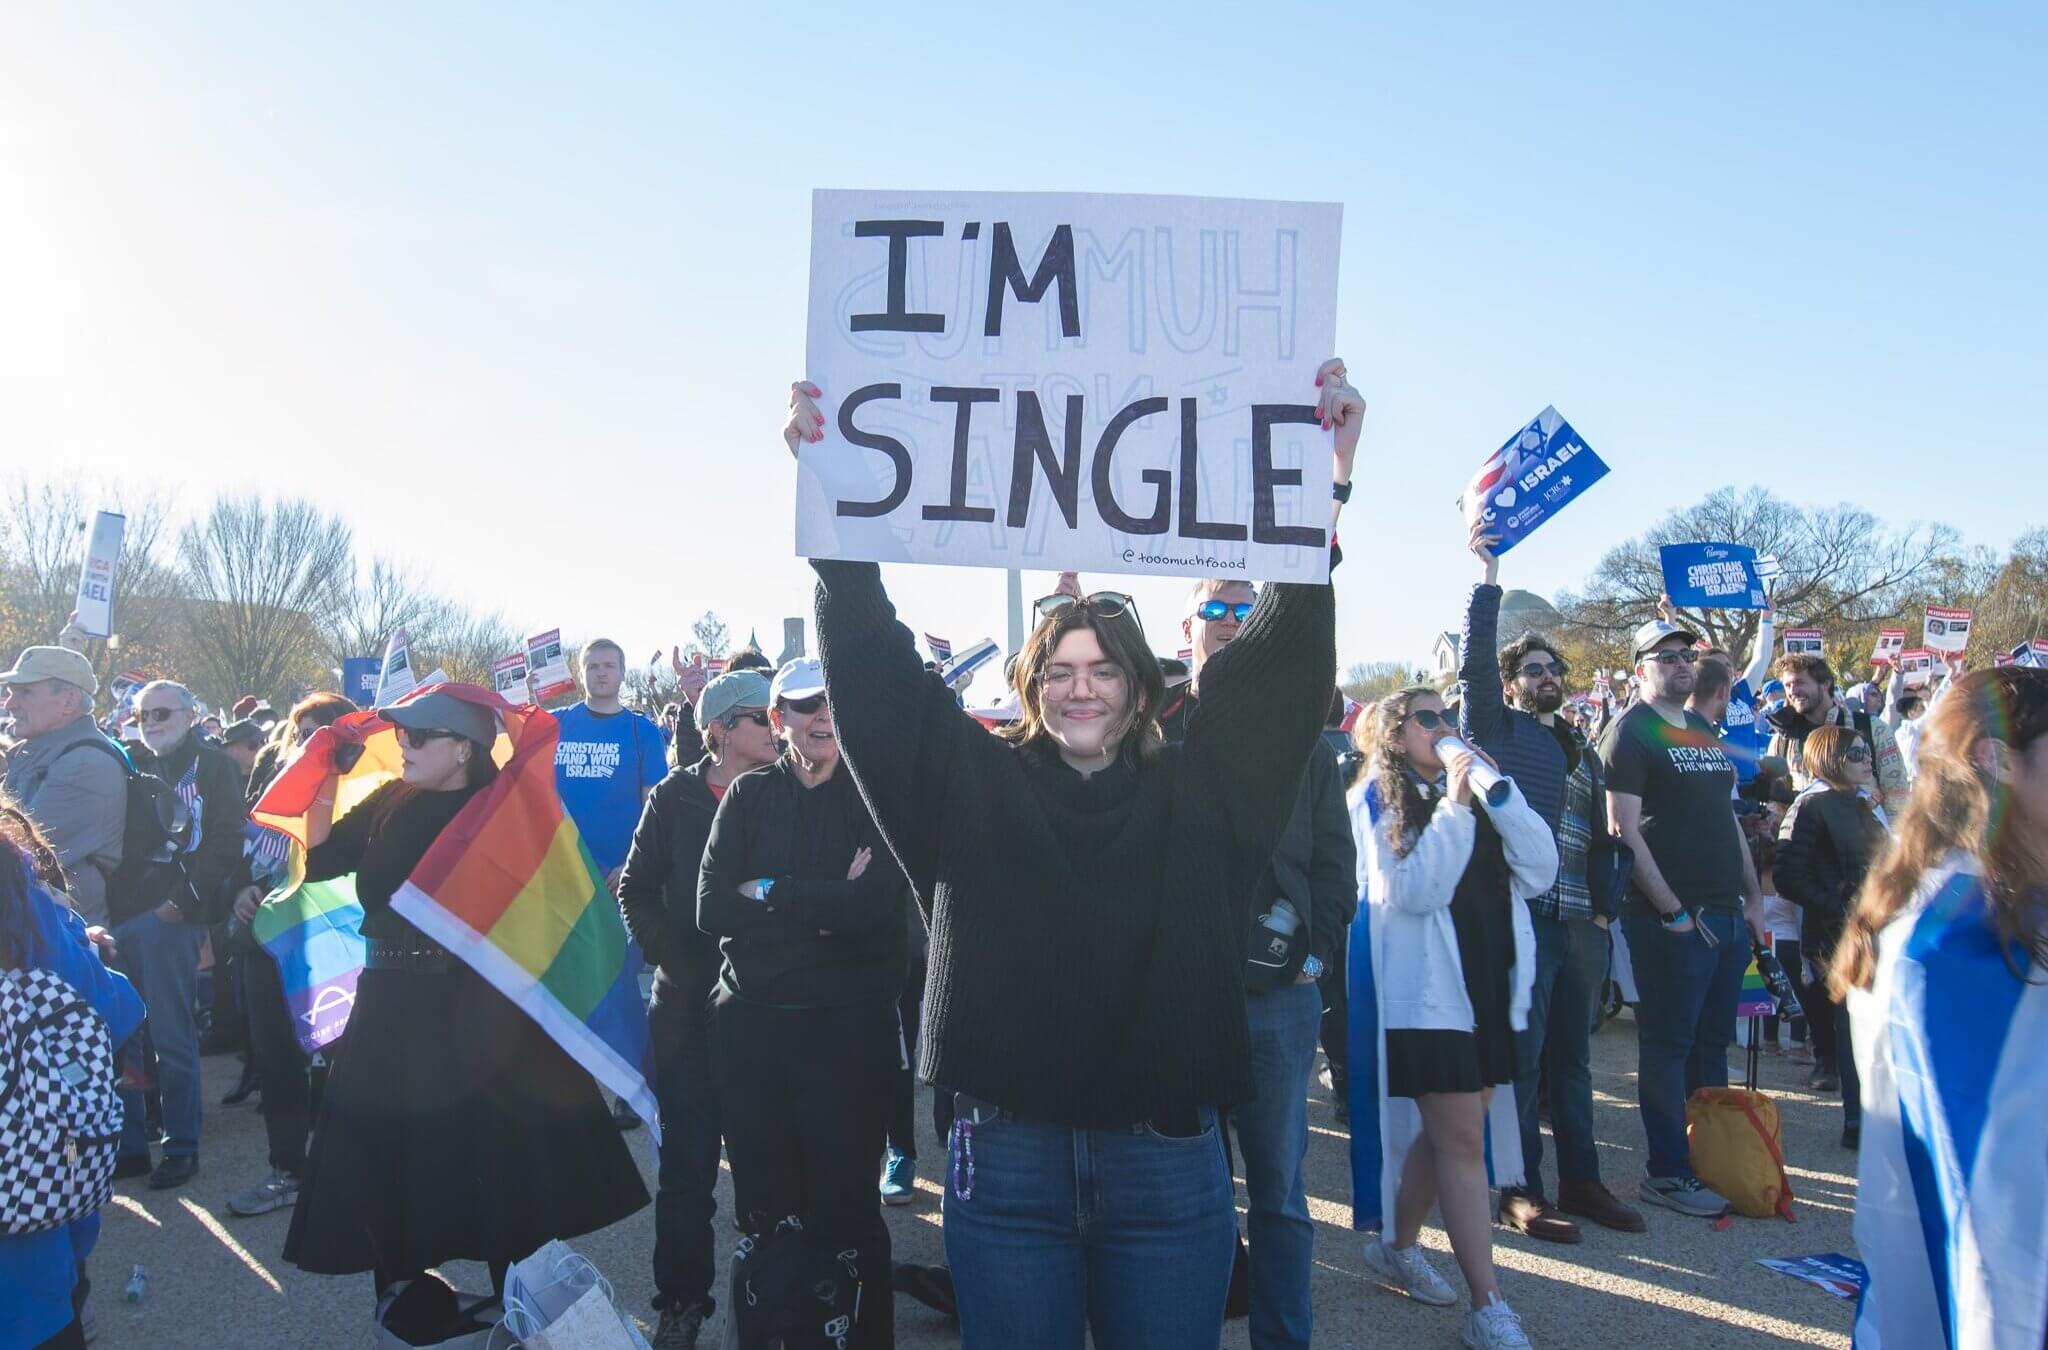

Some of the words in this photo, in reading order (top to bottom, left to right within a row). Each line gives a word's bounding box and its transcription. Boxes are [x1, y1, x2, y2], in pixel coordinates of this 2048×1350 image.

[850, 219, 1080, 337] I'M
[836, 383, 1326, 548] SINGLE
[1518, 441, 1584, 493] ISRAEL
[1687, 560, 1744, 578] CHRISTIANS
[1688, 575, 1722, 588] STAND
[1722, 571, 1748, 584] WITH
[1927, 609, 1970, 619] KIDNAPPED
[556, 741, 620, 754] CHRISTIANS
[1667, 746, 1727, 762] REPAIR
[554, 753, 588, 765] STAND
[590, 753, 620, 766] WITH
[565, 765, 604, 778] ISRAEL
